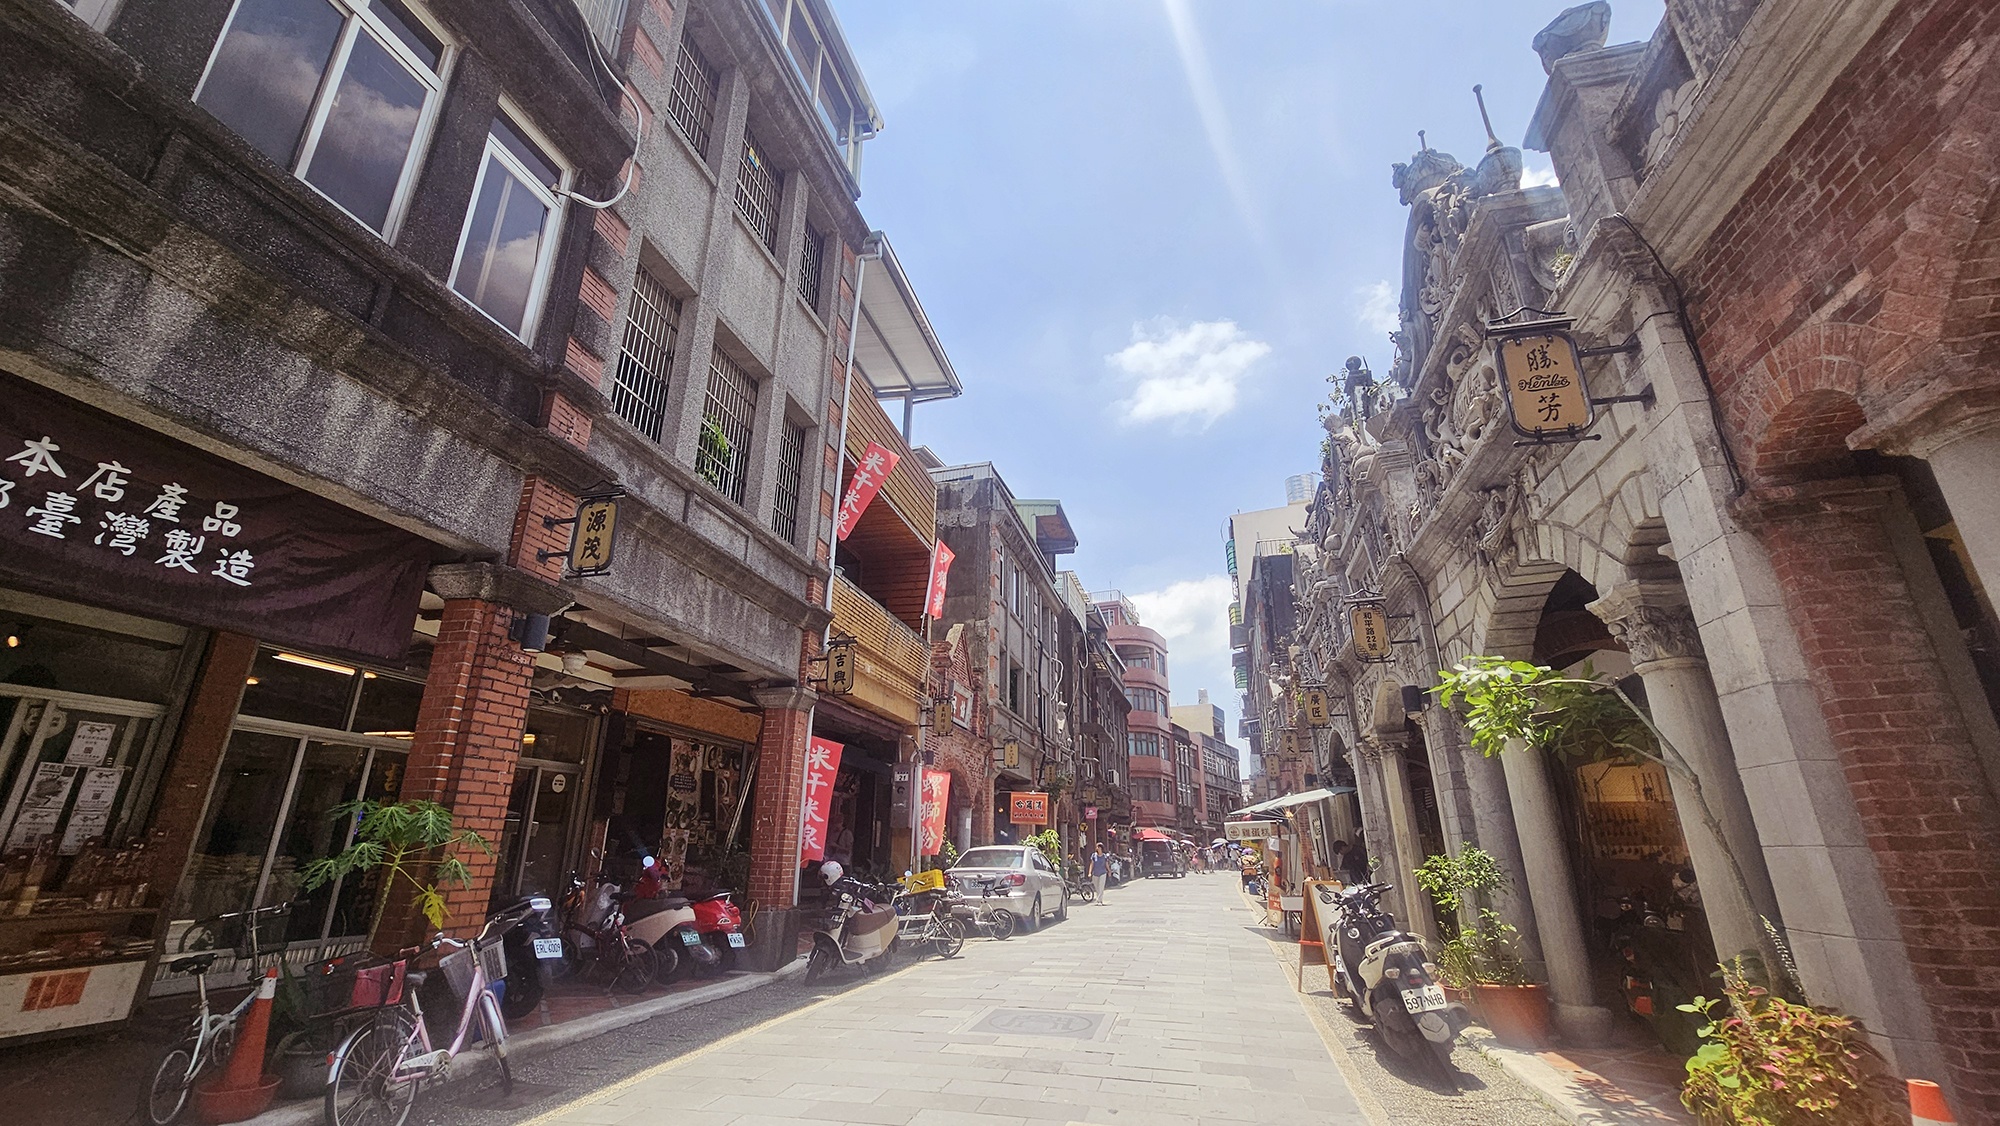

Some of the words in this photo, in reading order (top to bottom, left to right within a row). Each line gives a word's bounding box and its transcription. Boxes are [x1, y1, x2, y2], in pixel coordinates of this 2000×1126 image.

[5, 436, 242, 538] 本店產品
[580, 508, 607, 561] 源茂
[1363, 611, 1378, 651] 和平路22號
